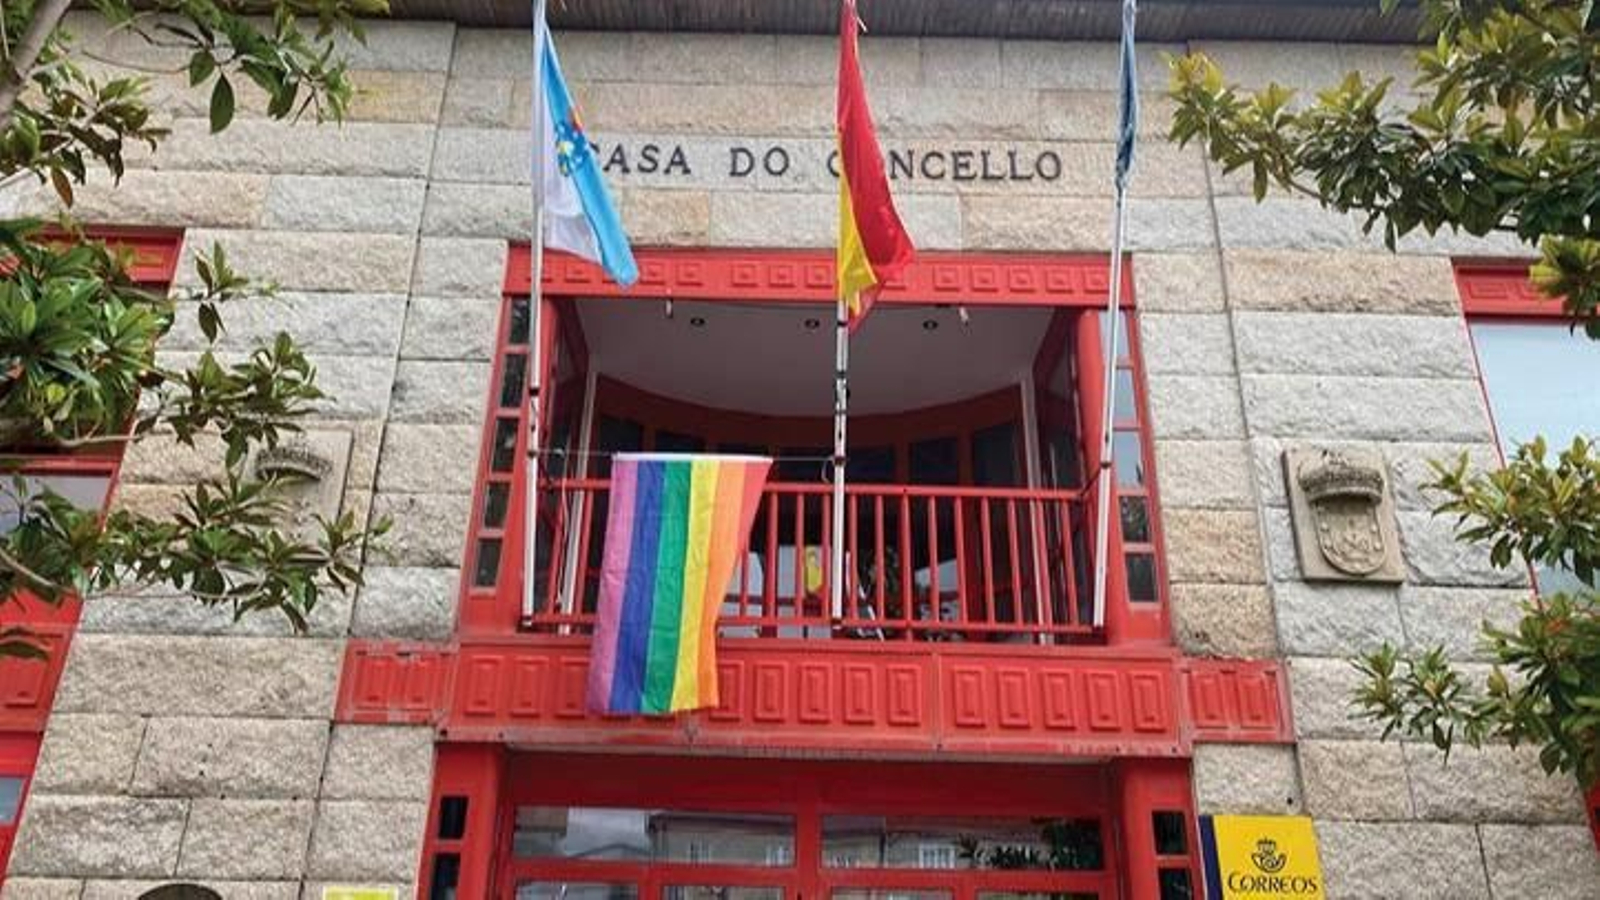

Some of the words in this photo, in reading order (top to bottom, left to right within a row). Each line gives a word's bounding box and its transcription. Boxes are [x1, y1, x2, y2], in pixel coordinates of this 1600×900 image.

[589, 141, 692, 175] ASA
[729, 146, 790, 177] DO
[827, 149, 1062, 180] CNCELLO
[1228, 871, 1318, 894] CORREOS
